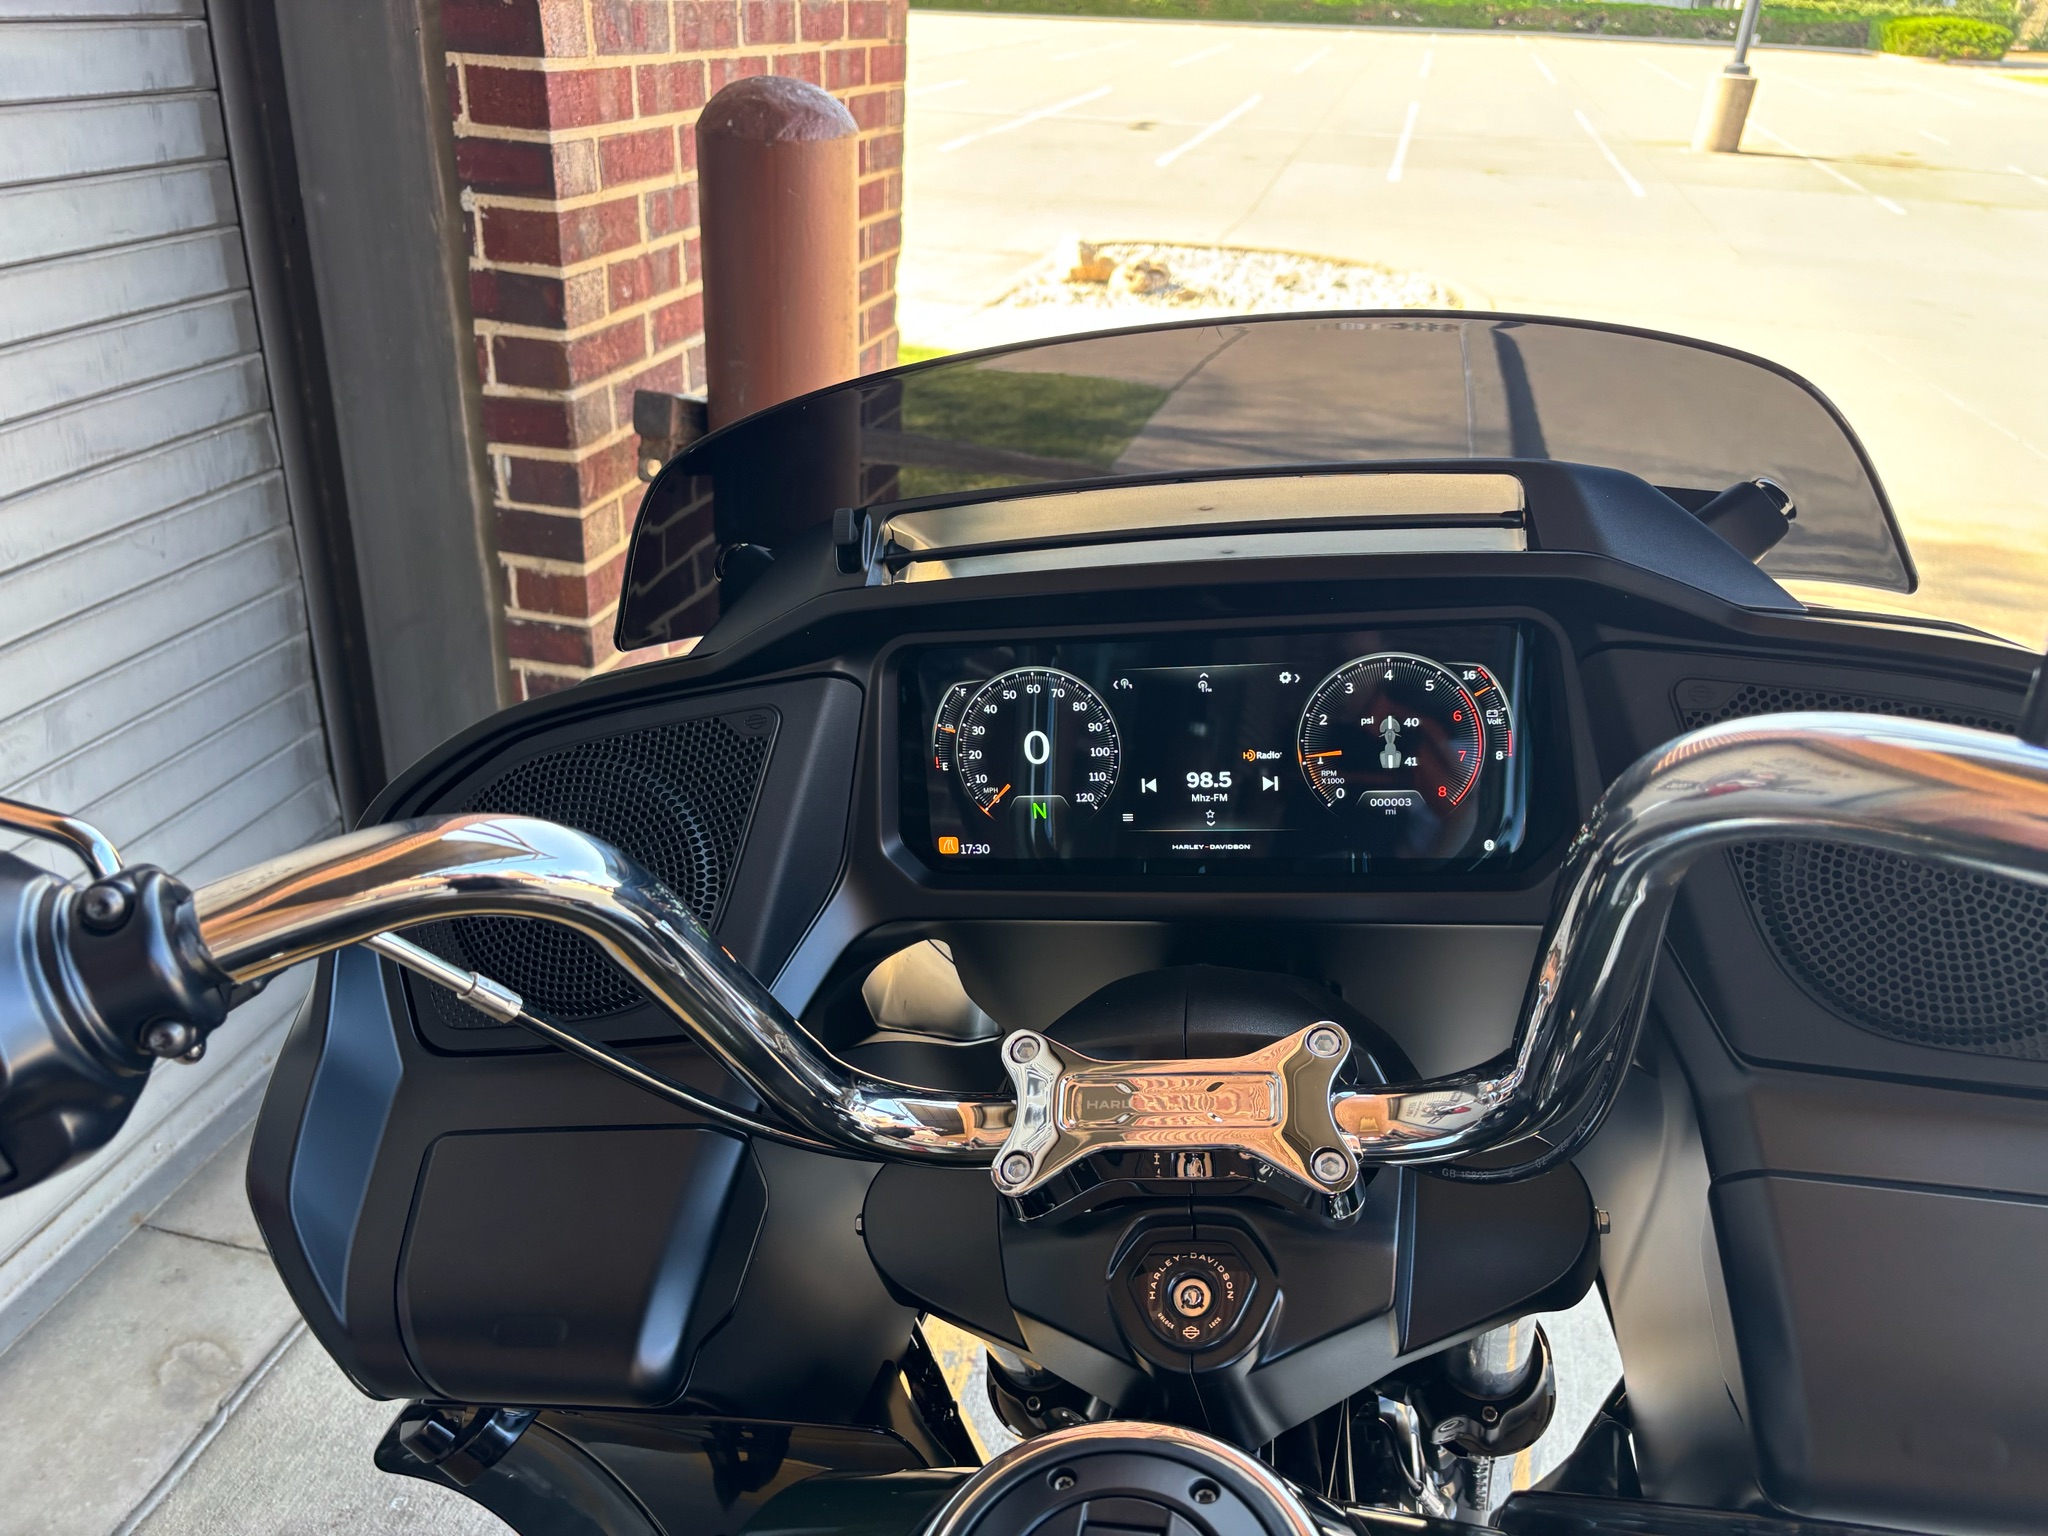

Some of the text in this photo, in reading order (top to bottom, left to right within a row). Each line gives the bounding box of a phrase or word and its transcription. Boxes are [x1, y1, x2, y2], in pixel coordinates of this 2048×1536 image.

[1384, 670, 1393, 680] 4
[1463, 671, 1476, 680] 16
[1026, 684, 1041, 694] 60
[1344, 684, 1354, 694] 3
[1425, 680, 1434, 691] 5
[960, 688, 967, 697] F
[1002, 690, 1017, 700] 50
[1051, 688, 1065, 698] 70
[983, 704, 998, 714] 40
[1072, 702, 1087, 712] 80
[1319, 715, 1328, 725] 2
[1453, 711, 1462, 721] 6
[1360, 717, 1374, 726] psi
[1403, 718, 1420, 727] 40
[971, 726, 986, 736] 30
[1088, 722, 1103, 732] 90
[1024, 730, 1050, 765] 0
[1090, 747, 1110, 757] 100
[968, 751, 983, 760] 20
[1256, 750, 1281, 760] Radio
[1458, 750, 1467, 761] 7
[1495, 751, 1504, 760] 8
[942, 762, 949, 771] E
[1404, 757, 1418, 766] 41
[975, 774, 988, 783] 10
[1088, 772, 1107, 782] 110
[1186, 771, 1233, 788] 98.5
[1335, 788, 1345, 799] 0
[1437, 786, 1447, 797] 8
[1075, 794, 1094, 803] 120
[1191, 793, 1228, 803] Mhz-FM
[1370, 798, 1412, 807] 000003
[1032, 802, 1047, 820] N
[960, 844, 991, 855] 17:30
[1149, 1252, 1234, 1300] HARLEY-DAVIDSON
[1208, 1316, 1222, 1329] LOCK
